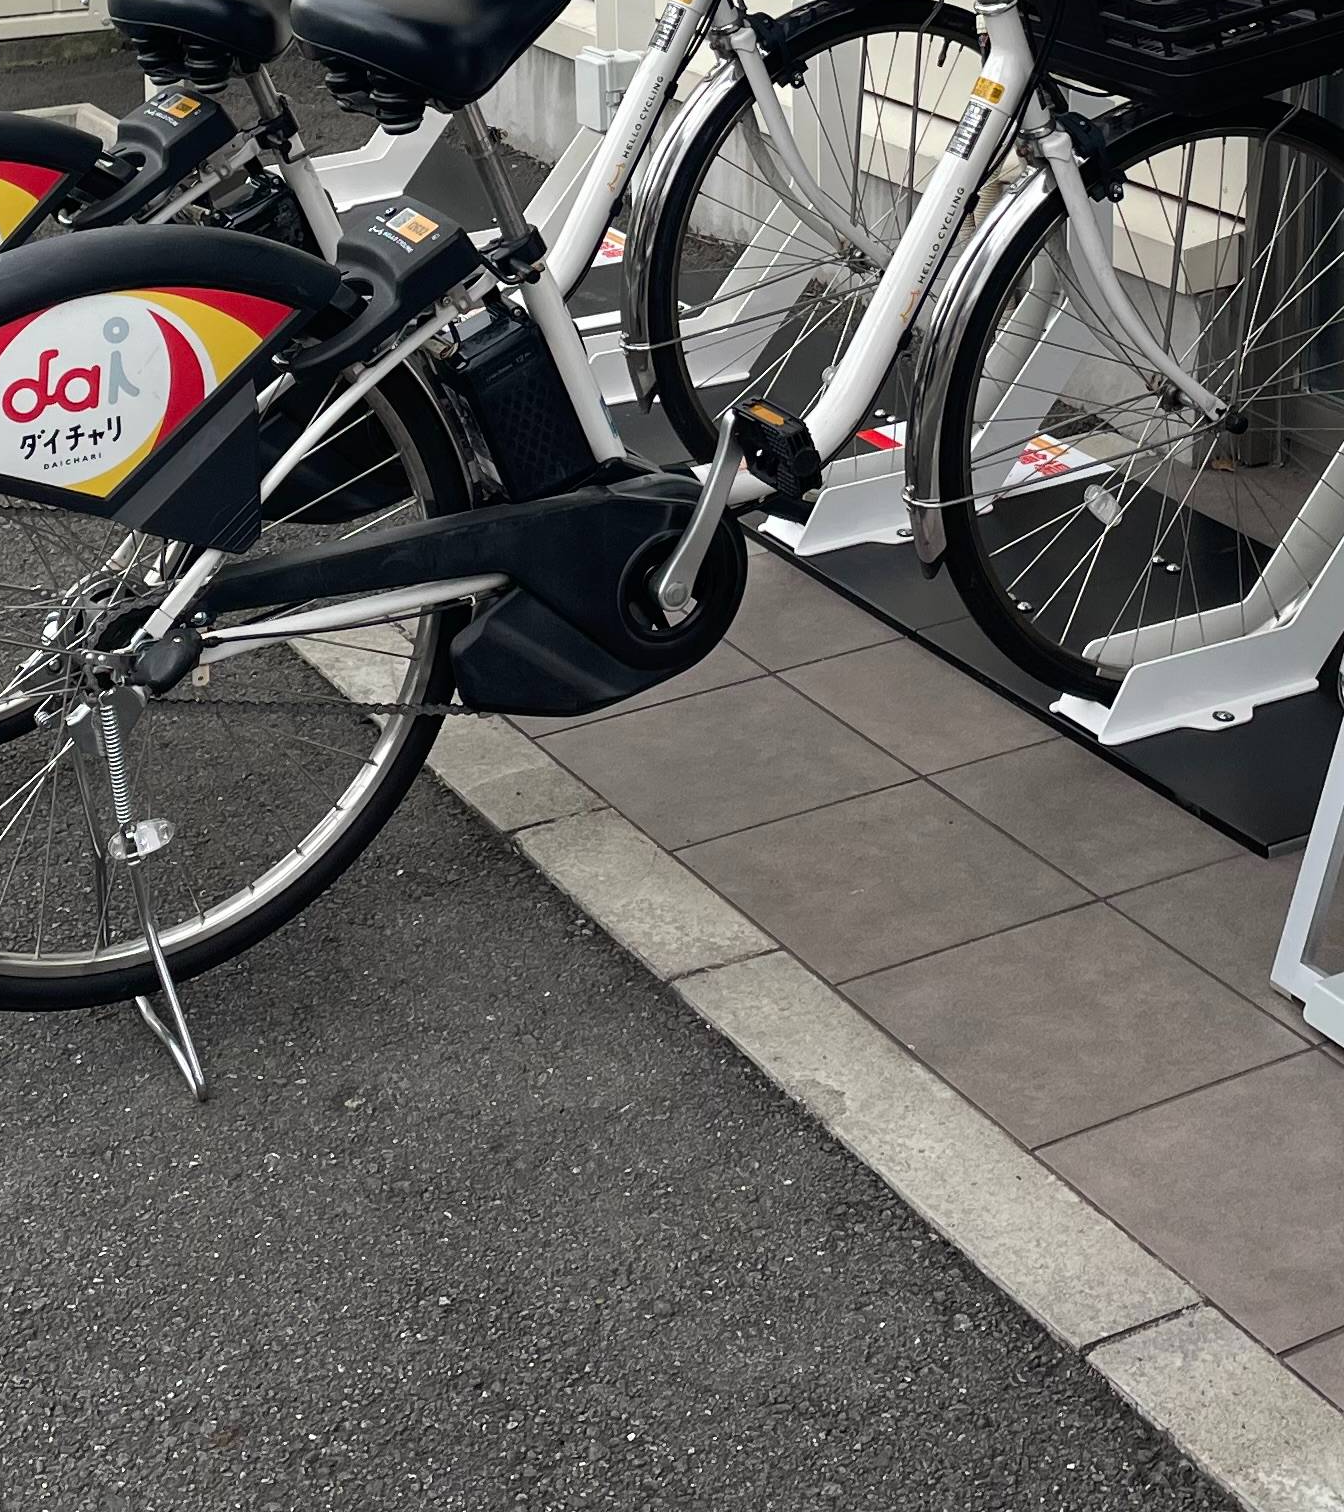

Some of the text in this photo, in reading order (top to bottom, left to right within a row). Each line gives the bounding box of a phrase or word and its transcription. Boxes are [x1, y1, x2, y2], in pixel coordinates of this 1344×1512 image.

[622, 74, 664, 158] HELLO CYCLING
[918, 187, 965, 284] HELLO CYCLING
[2, 316, 141, 424] dai
[19, 415, 123, 460] ダイチャリ
[43, 452, 103, 470] DAICHARI
